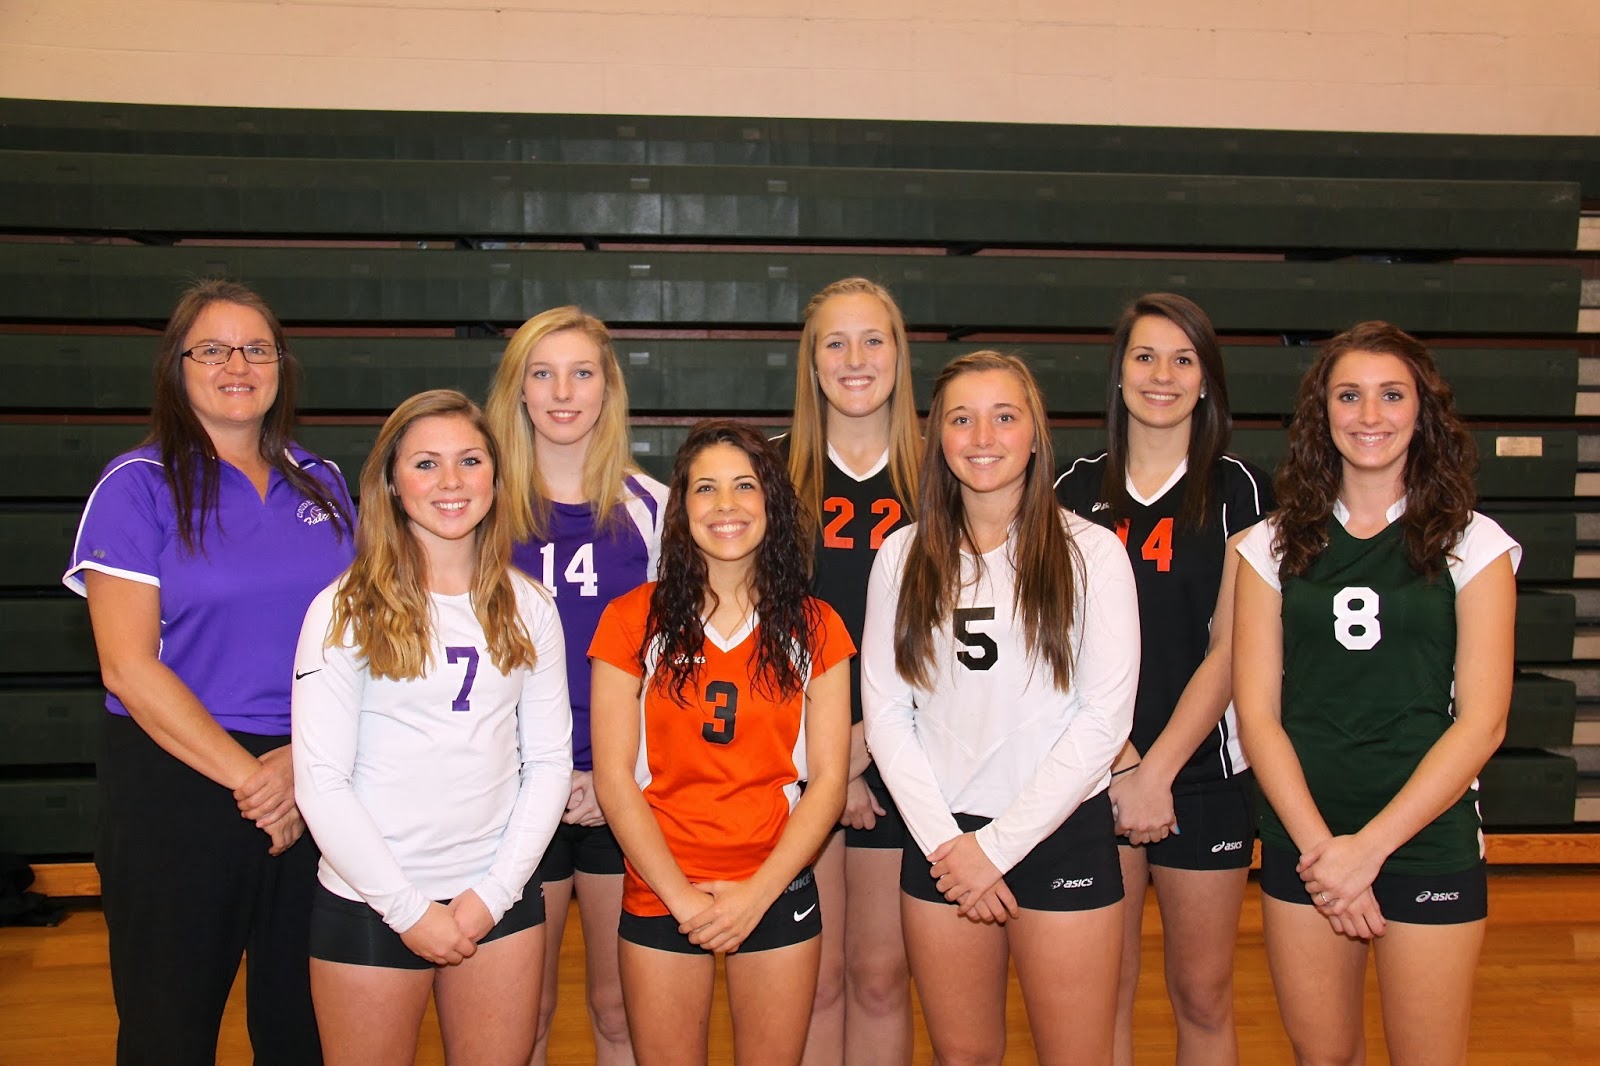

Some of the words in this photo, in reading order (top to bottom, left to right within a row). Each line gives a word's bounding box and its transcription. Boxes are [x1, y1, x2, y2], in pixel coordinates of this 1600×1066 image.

[824, 497, 901, 550] 22
[540, 543, 598, 597] 14
[953, 607, 998, 670] 5
[1333, 587, 1381, 650] 8
[445, 646, 479, 711] 7
[702, 681, 738, 744] 3
[1224, 841, 1242, 851] asics
[1063, 877, 1094, 889] asics
[1431, 892, 1459, 901] asics
